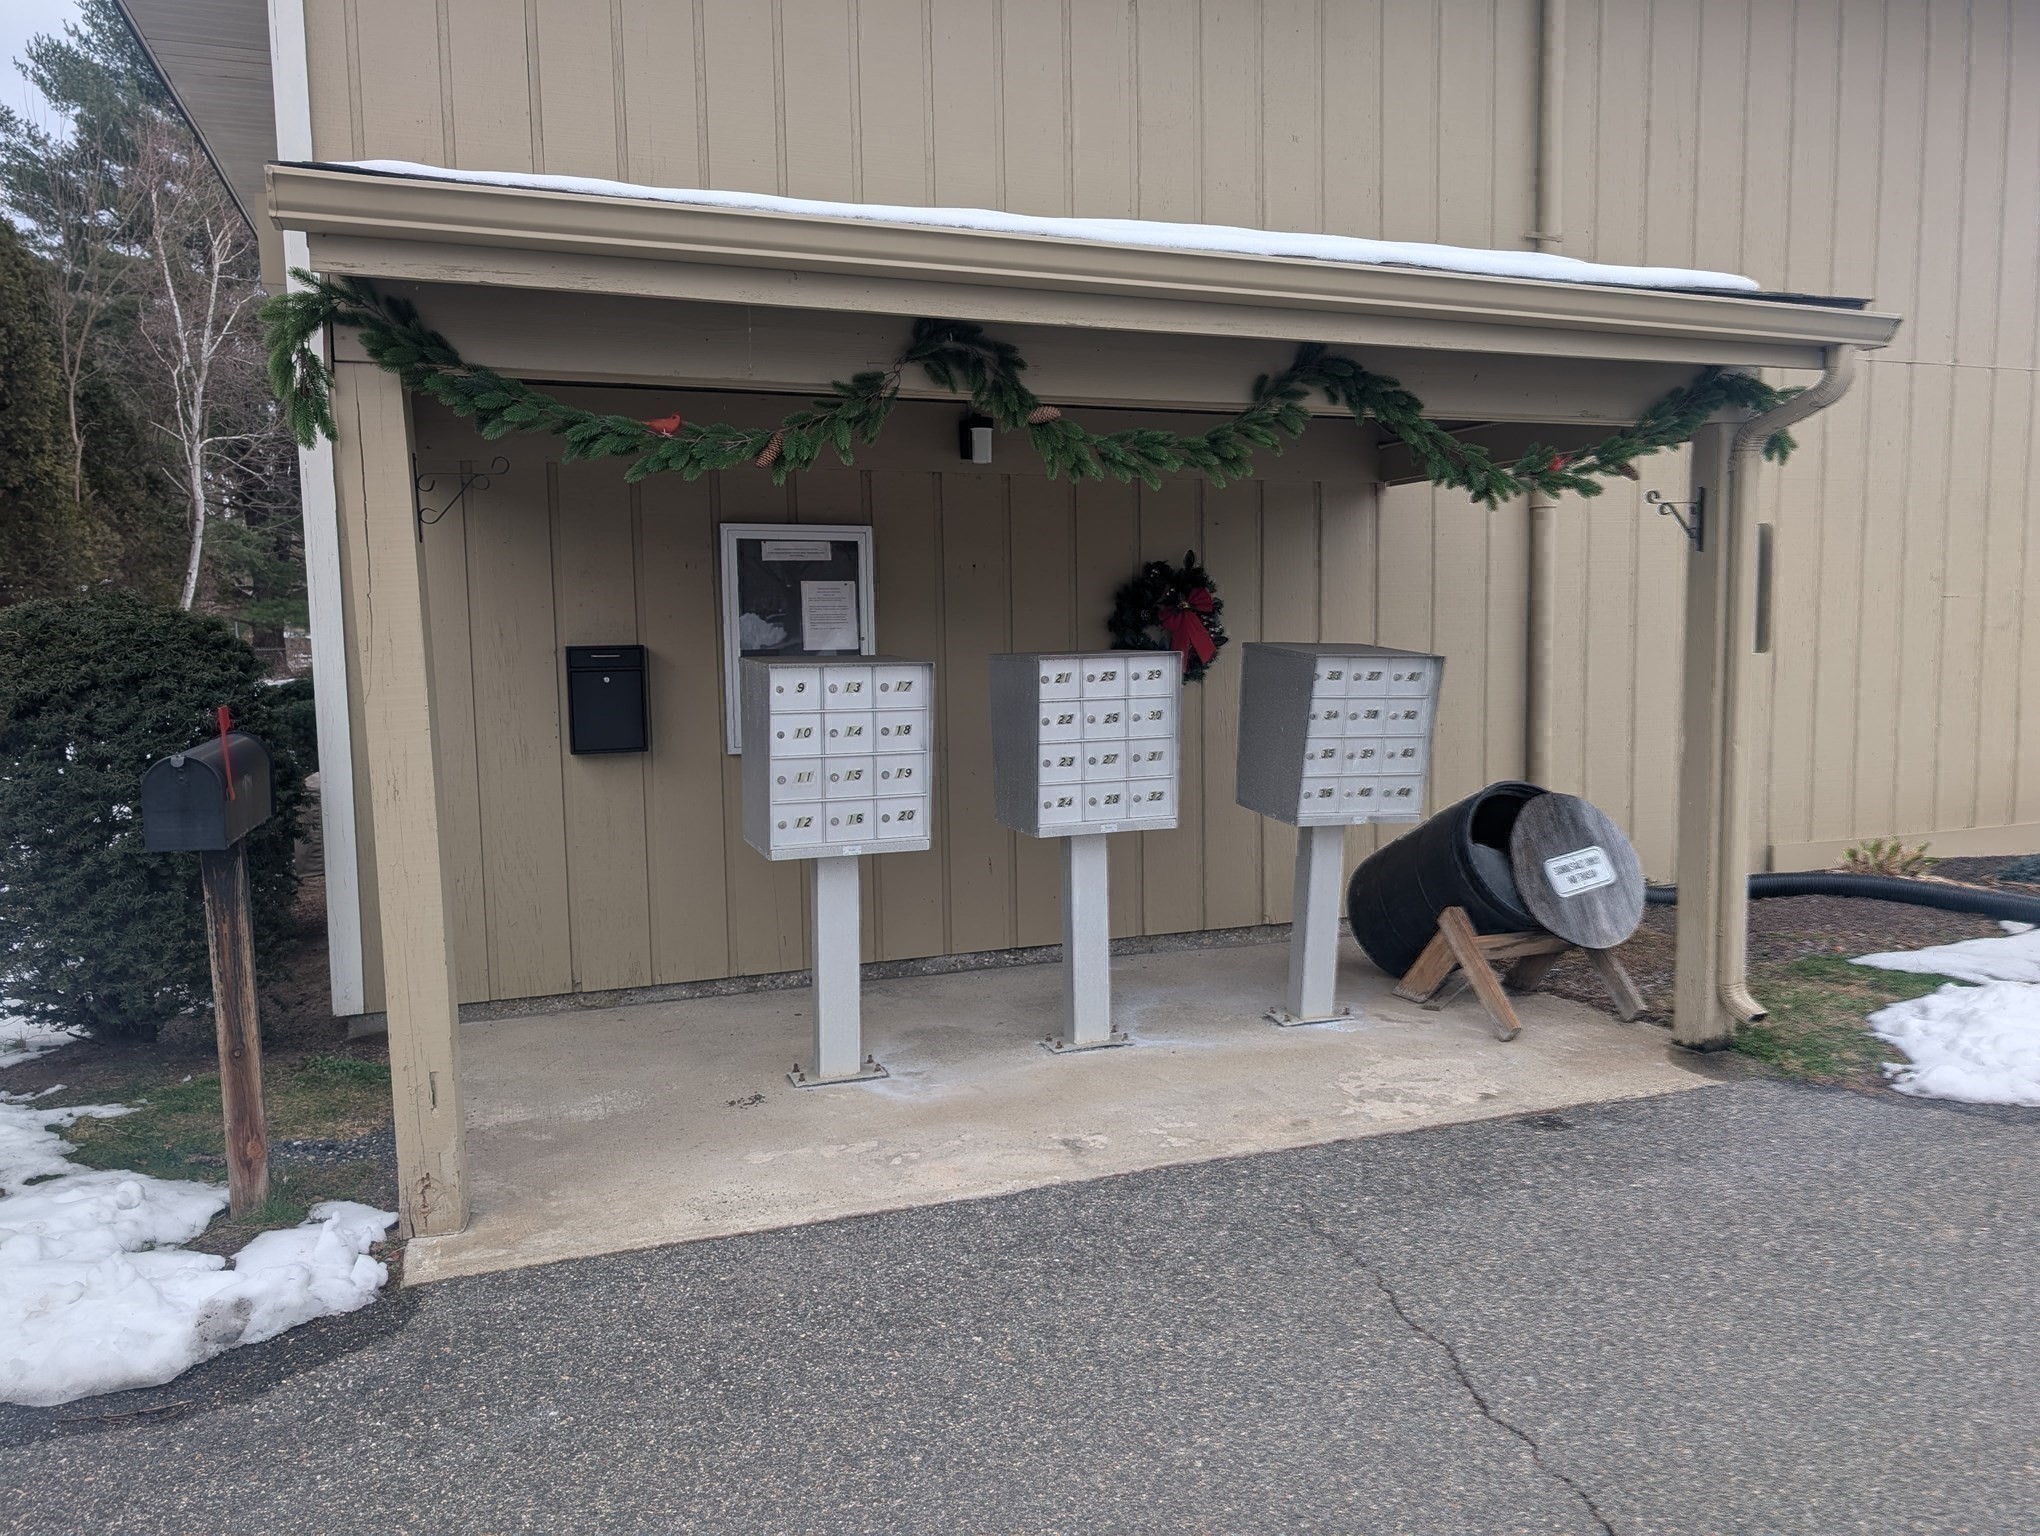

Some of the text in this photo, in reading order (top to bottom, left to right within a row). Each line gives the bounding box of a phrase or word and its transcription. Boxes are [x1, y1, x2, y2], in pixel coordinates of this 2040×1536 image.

[1055, 673, 1070, 683] 21
[1101, 672, 1116, 681] 25
[1148, 670, 1161, 680] 29
[1327, 671, 1343, 680] 33
[846, 683, 861, 692] 13
[897, 681, 912, 691] 17
[1058, 714, 1073, 724] 22
[1105, 714, 1118, 723] 26
[1148, 711, 1162, 720] 30
[1364, 710, 1377, 719] 38
[796, 728, 811, 738] 10
[847, 727, 862, 736] 14
[896, 726, 911, 735] 18
[1148, 752, 1162, 761] 31
[1321, 749, 1335, 758] 35
[1361, 750, 1374, 759] 39
[1060, 757, 1073, 767] 23
[1103, 754, 1118, 764] 27
[798, 772, 811, 782] 11
[847, 770, 862, 780] 15
[897, 769, 912, 779] 19
[1148, 792, 1163, 801] 32
[1319, 788, 1333, 797] 36
[1058, 798, 1072, 807] 24
[1105, 795, 1119, 804] 28
[849, 814, 863, 824] 16
[898, 811, 914, 821] 20
[796, 817, 812, 827] 12
